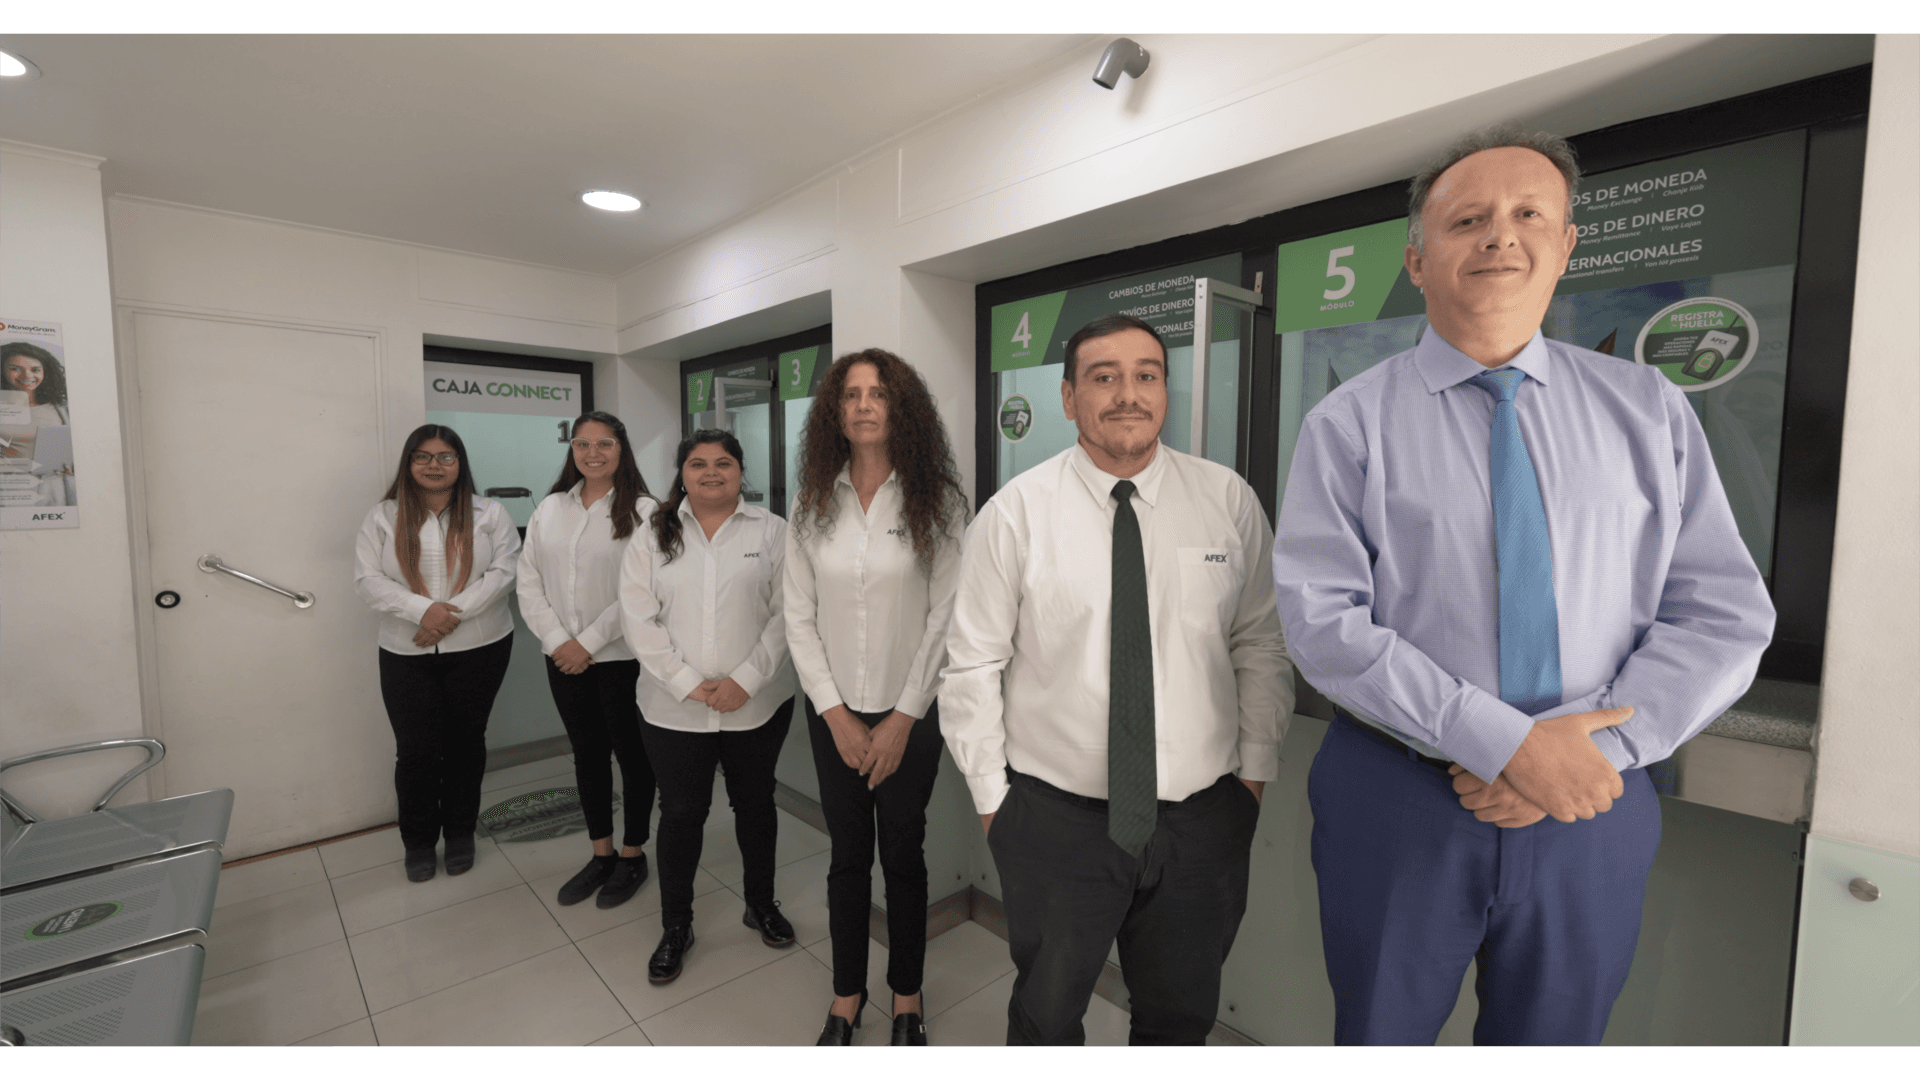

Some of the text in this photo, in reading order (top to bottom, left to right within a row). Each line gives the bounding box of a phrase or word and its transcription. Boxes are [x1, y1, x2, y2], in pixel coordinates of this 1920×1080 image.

[1595, 186, 1619, 202] DE
[1623, 168, 1707, 196] MONEDA
[1586, 201, 1609, 212] Money
[1610, 196, 1643, 208] Exchange
[1603, 217, 1627, 233] DE
[1631, 203, 1705, 228] DINERO
[1579, 235, 1602, 246] Money
[1602, 230, 1641, 242] Remittance
[1568, 239, 1703, 271] ERNACIONALES
[1323, 245, 1356, 300] 5
[1595, 266, 1625, 275] transfers
[1108, 274, 1195, 300] CAMBIOS DE MONEDA
[1149, 304, 1160, 314] DE
[1162, 297, 1195, 312] DINERO
[1320, 300, 1355, 312] MÓDULO
[1670, 310, 1725, 322] REGISTRA
[1679, 319, 1725, 329] HUELLA
[1010, 311, 1032, 349] 4
[1710, 337, 1729, 345] AFEX
[791, 358, 801, 386] 3
[432, 378, 572, 401] CAJA CONNECT
[696, 378, 704, 401] 2
[557, 420, 571, 443] 1
[32, 513, 63, 521] AFEX
[1204, 554, 1227, 563] AFEX
